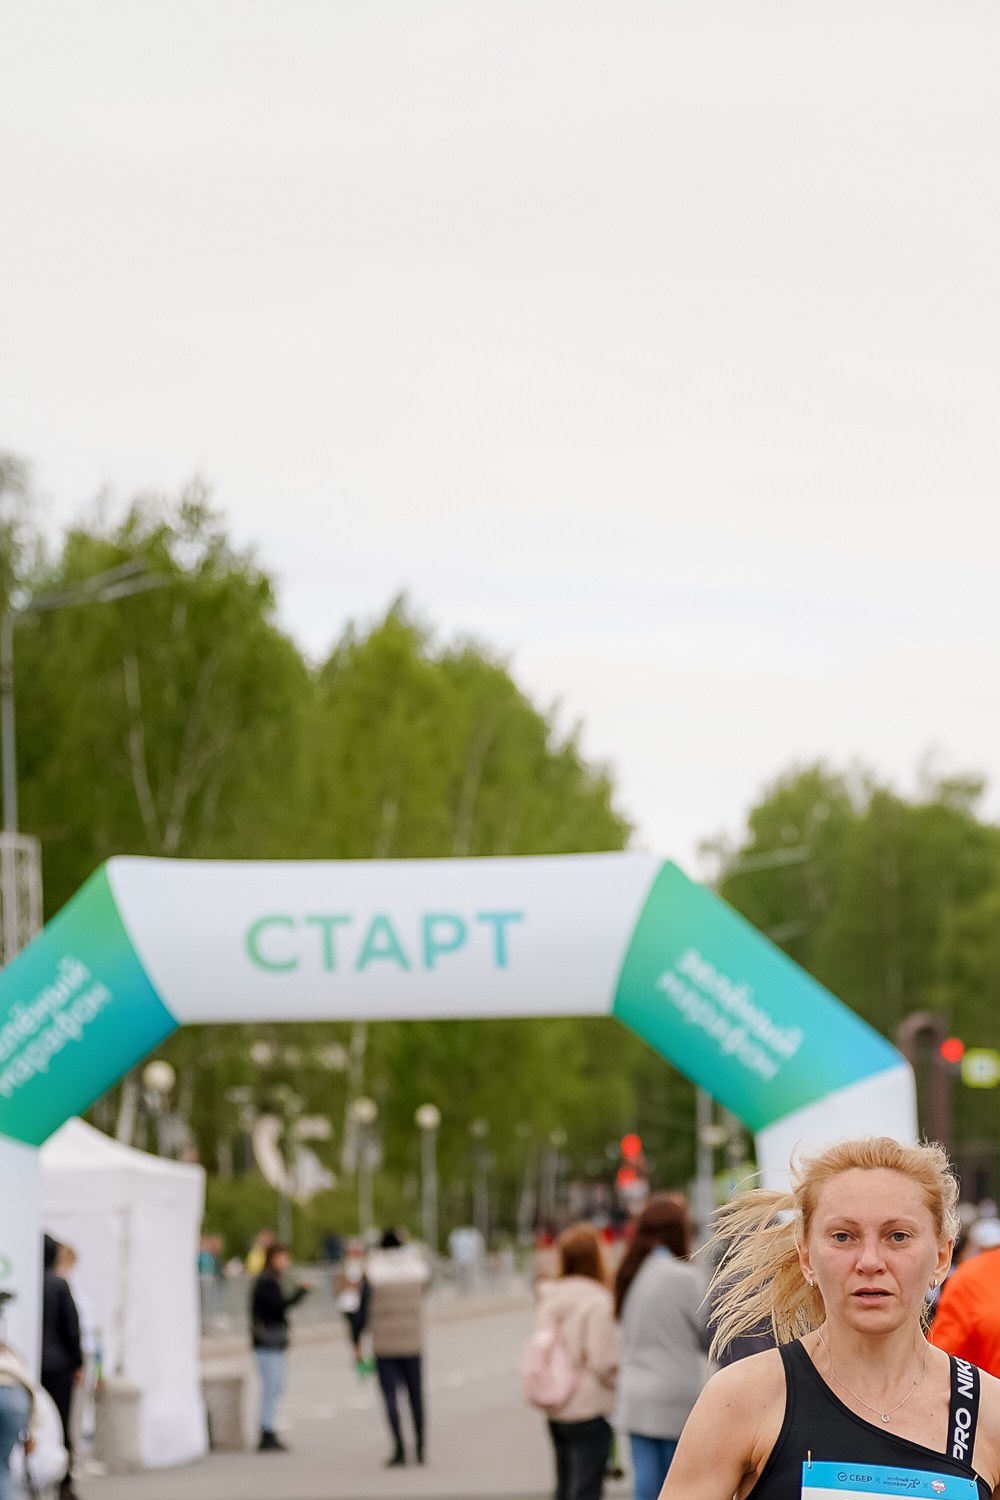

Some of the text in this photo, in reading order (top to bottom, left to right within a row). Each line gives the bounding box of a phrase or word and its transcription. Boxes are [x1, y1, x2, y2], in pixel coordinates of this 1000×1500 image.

[244, 908, 524, 974] СТАРТ
[952, 1356, 974, 1461] PRO NIK
[849, 1474, 873, 1483] СБЕР
